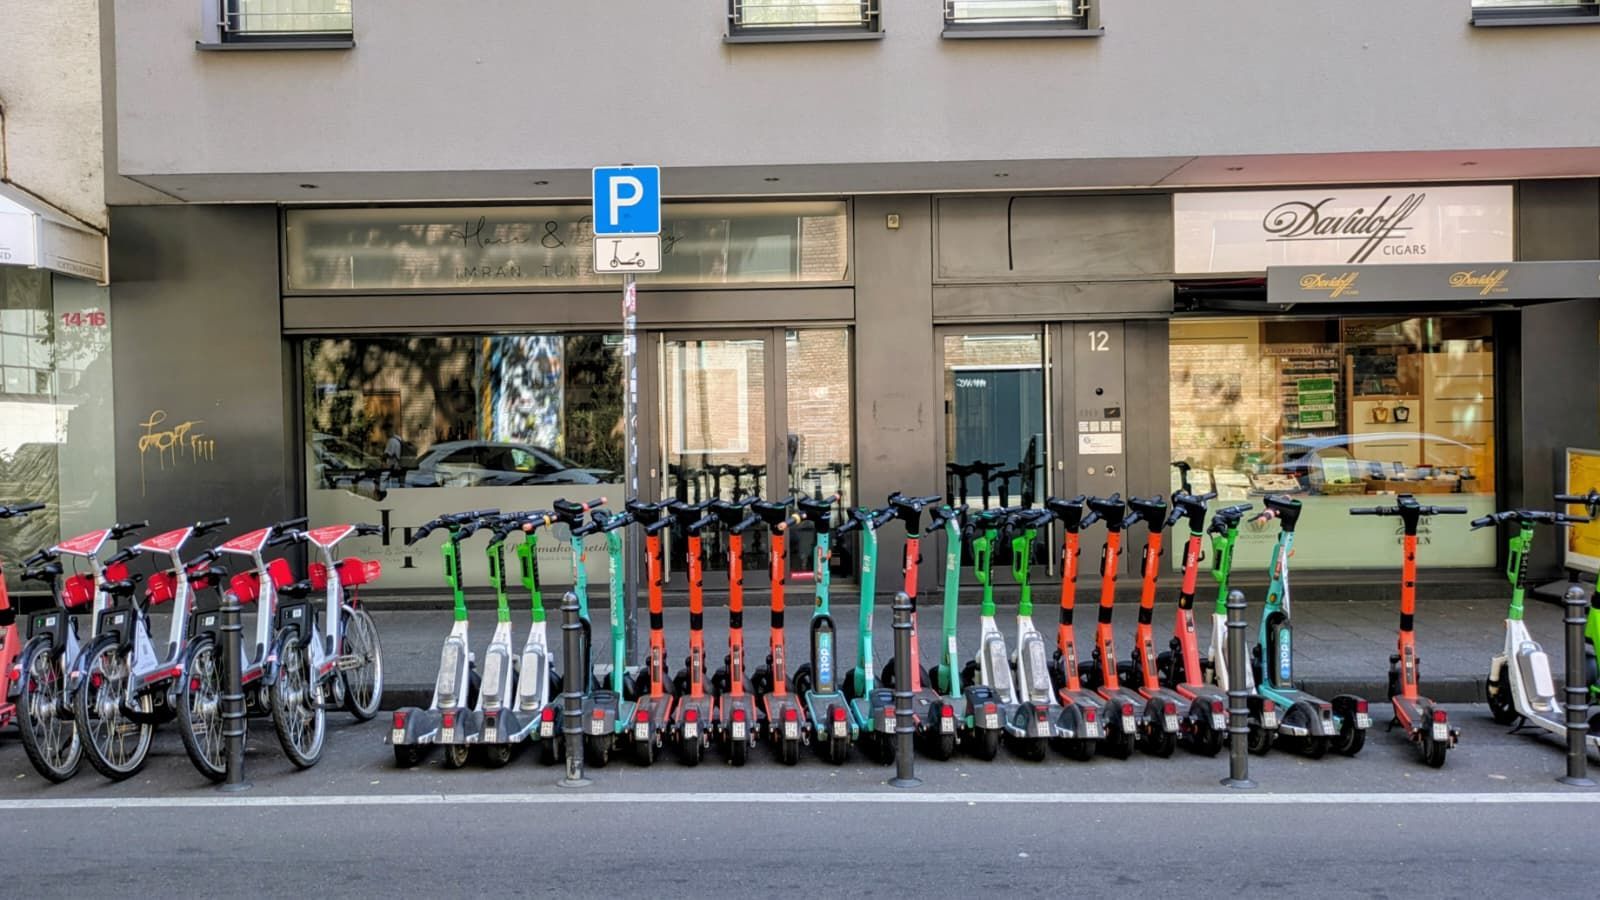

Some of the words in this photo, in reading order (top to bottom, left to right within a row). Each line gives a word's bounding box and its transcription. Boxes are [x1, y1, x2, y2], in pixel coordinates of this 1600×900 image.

[609, 176, 644, 225] P
[541, 220, 566, 248] &
[1263, 192, 1426, 264] Davidoff
[1383, 244, 1426, 256] CIGARS
[1300, 272, 1359, 298] Davidoff
[1449, 269, 1508, 295] Davidoff
[61, 312, 106, 326] 14-16
[1088, 331, 1110, 351] 12
[820, 648, 828, 674] dott
[1280, 645, 1289, 669] dott
